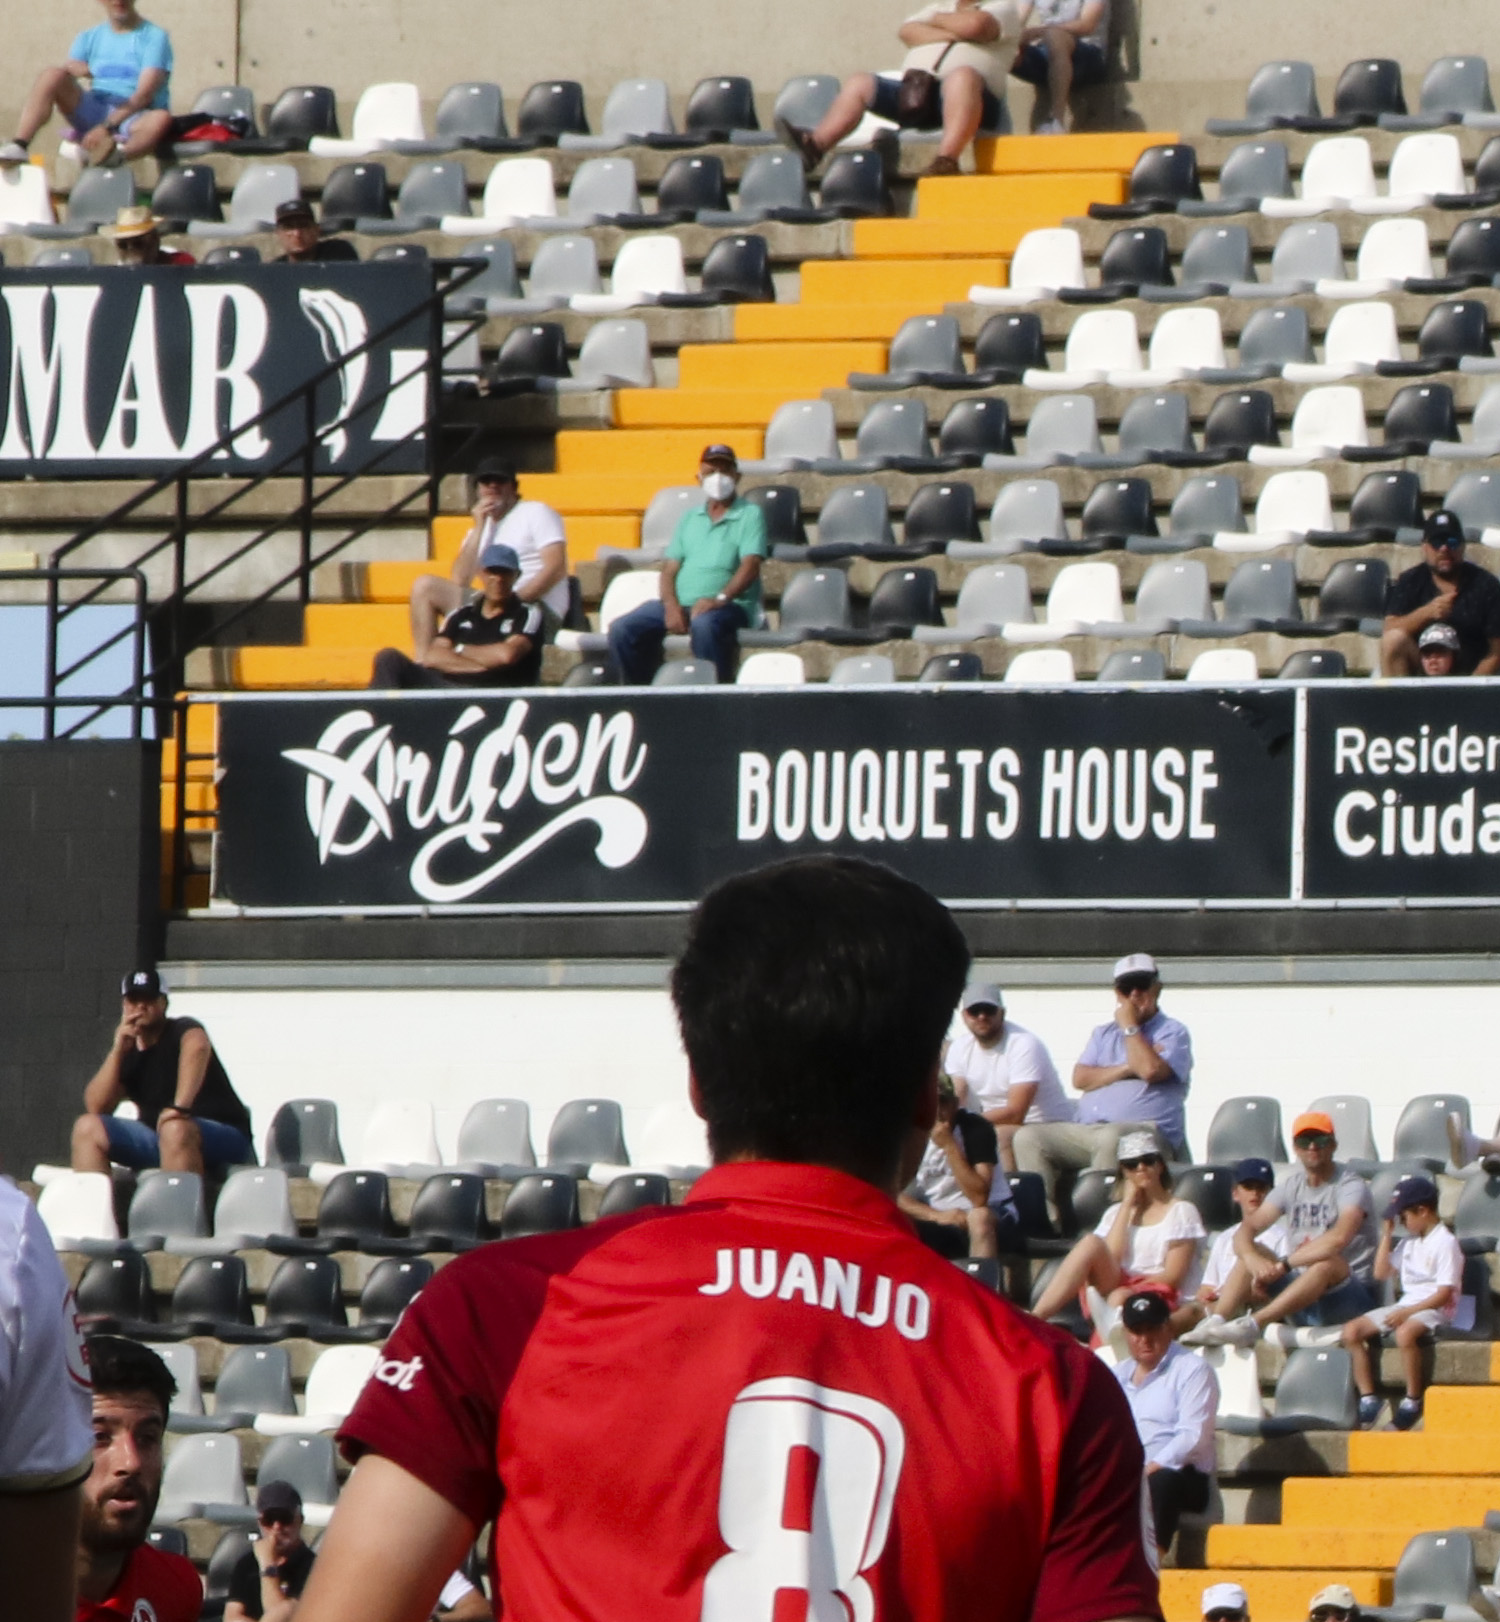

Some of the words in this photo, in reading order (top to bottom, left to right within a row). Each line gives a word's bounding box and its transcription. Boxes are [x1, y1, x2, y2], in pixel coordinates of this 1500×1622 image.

[0, 284, 270, 461] MAR
[737, 748, 1018, 841] BOUQUETS
[1039, 746, 1219, 841] HOUSE
[699, 1248, 931, 1341] JUANJO
